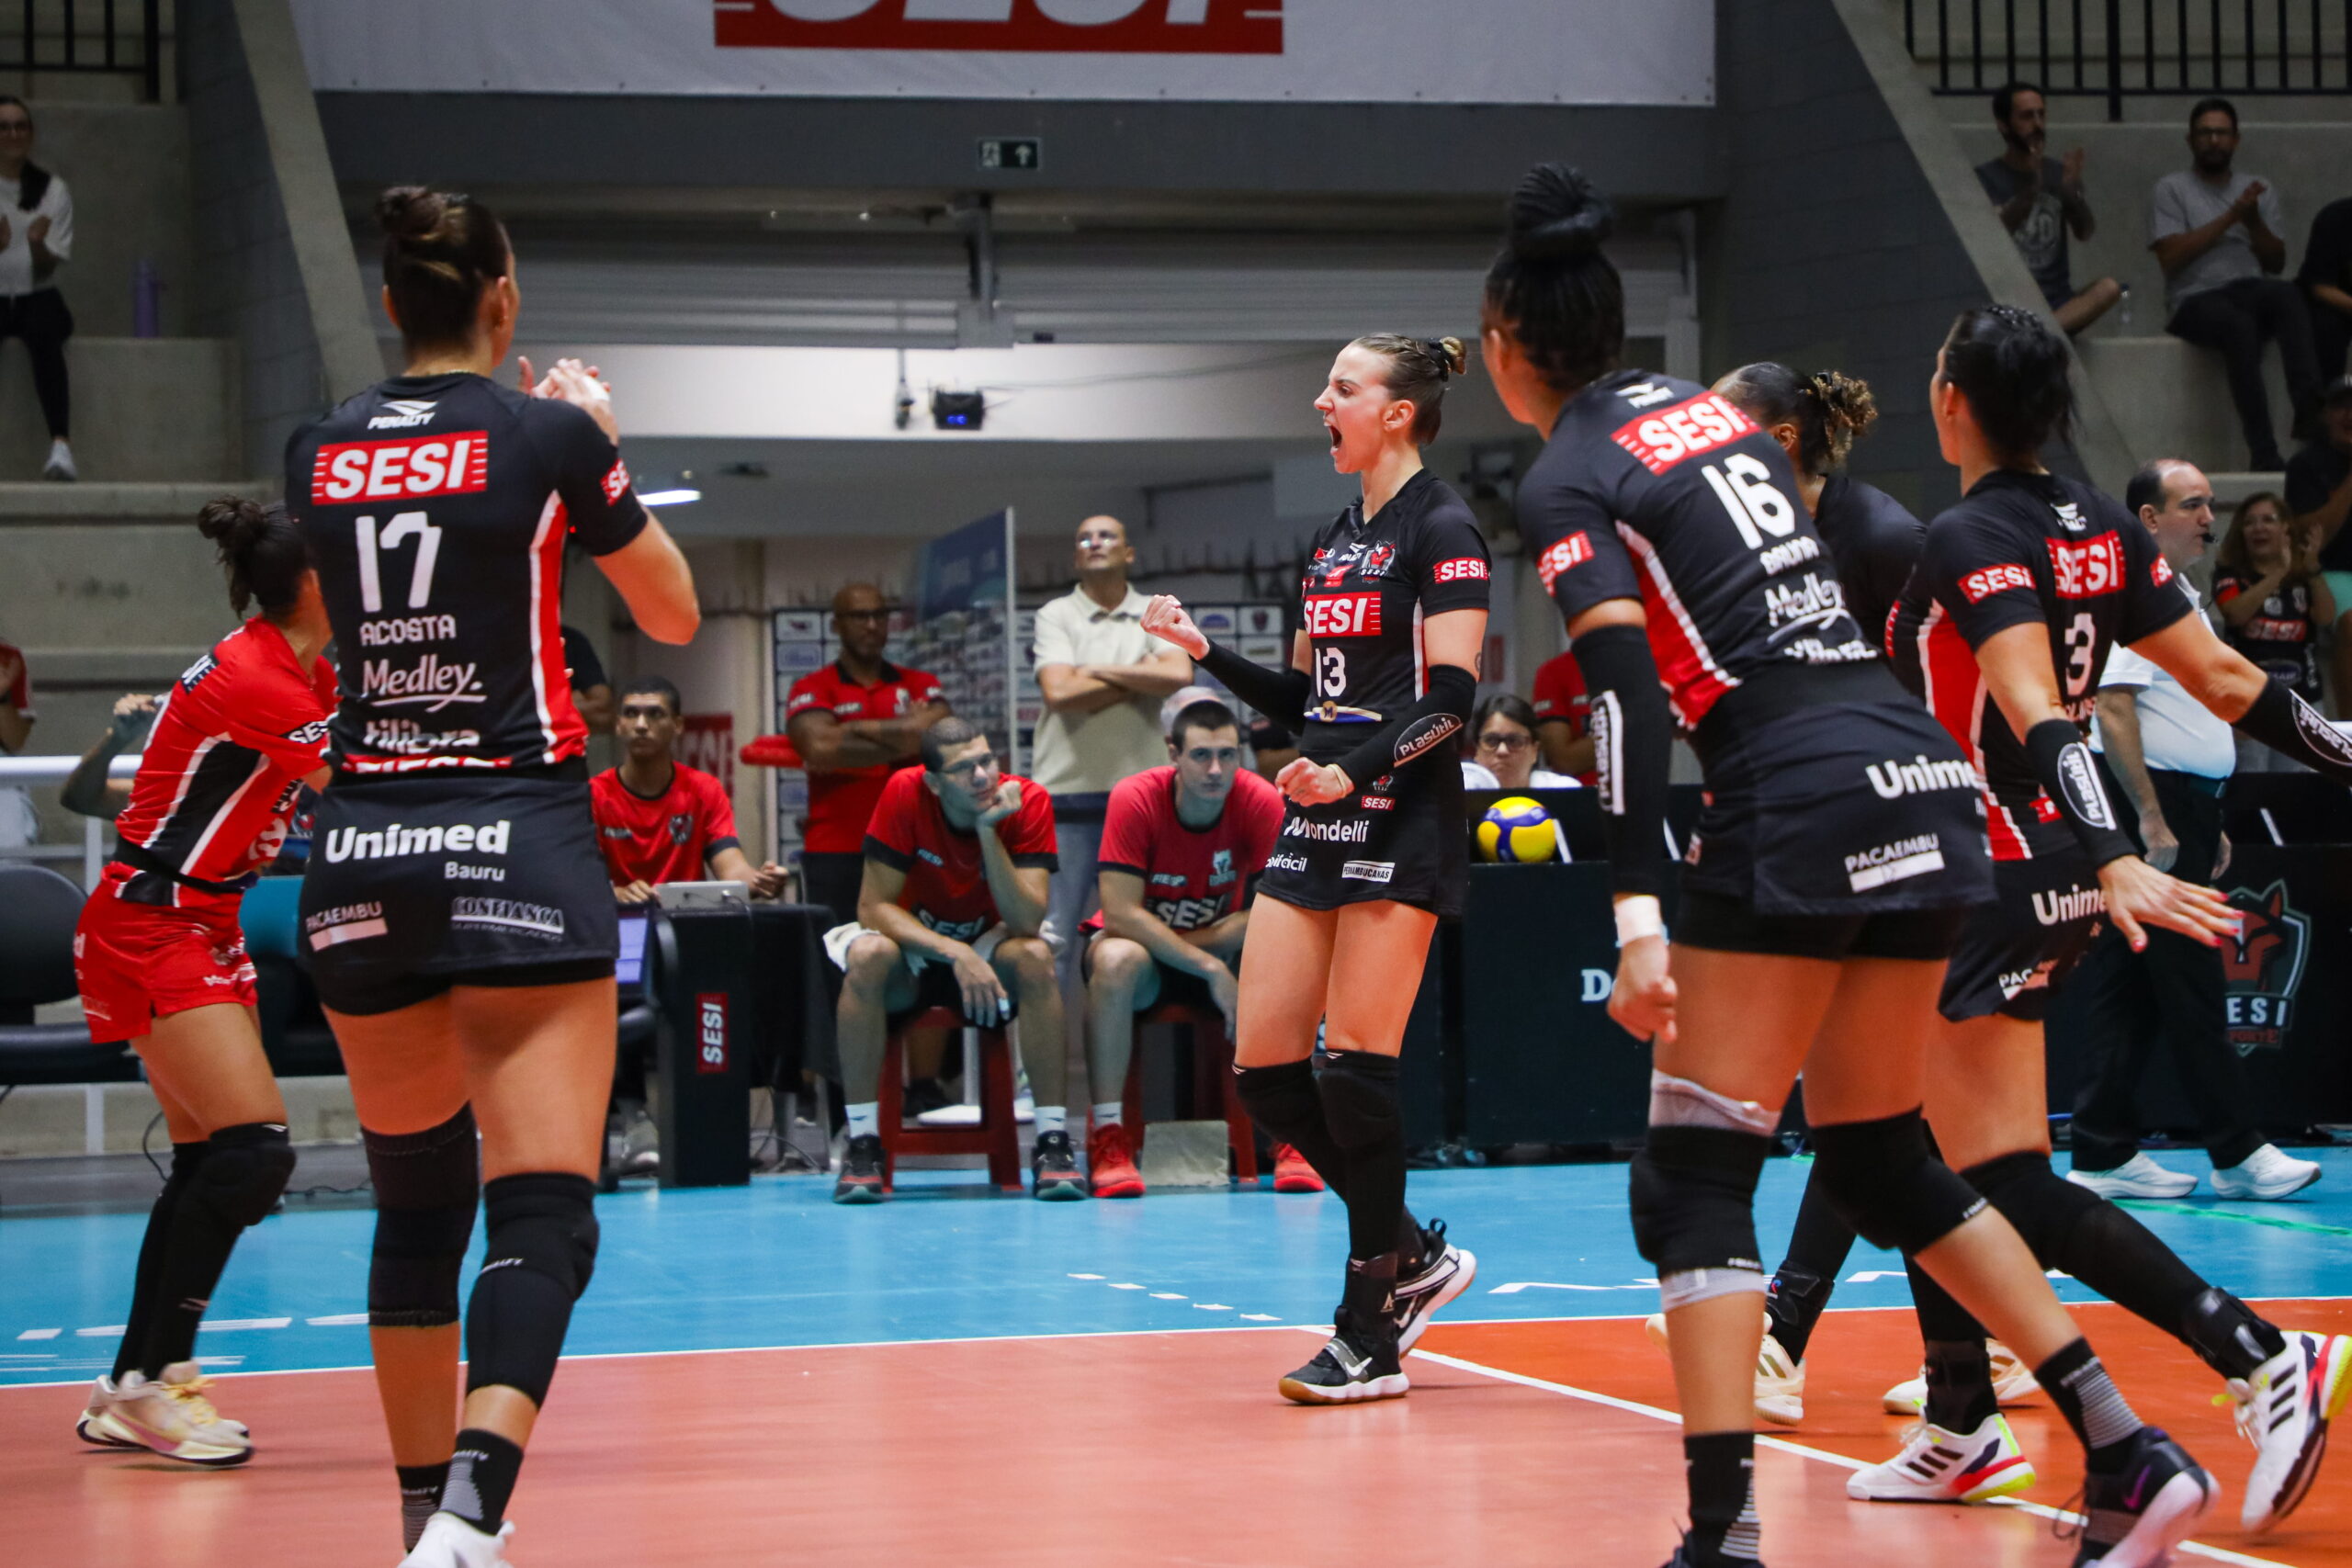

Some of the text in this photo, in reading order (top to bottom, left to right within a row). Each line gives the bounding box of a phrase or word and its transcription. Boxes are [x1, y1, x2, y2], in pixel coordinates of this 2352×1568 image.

[368, 412, 435, 430] PENALTY
[1638, 395, 1748, 462] SESI
[324, 439, 470, 500] SESI
[1701, 452, 1795, 550] 16
[355, 511, 442, 613] 17
[1440, 559, 1485, 581] SESI
[1967, 566, 2033, 598] SESI
[2055, 537, 2119, 594] SESI
[359, 614, 458, 647] ACOSTA
[1304, 598, 1368, 636] SESI
[1314, 646, 1347, 697] 13
[2064, 612, 2097, 696] 3
[1865, 755, 1977, 800] Unime
[1363, 797, 1393, 809] SESI
[324, 819, 511, 863] Unimed
[1283, 816, 1370, 842] Mondelli
[444, 861, 506, 882] Bauru
[1844, 832, 1939, 873] PACAEMBU
[2226, 996, 2288, 1027] ESI
[702, 1001, 723, 1065] SESI
